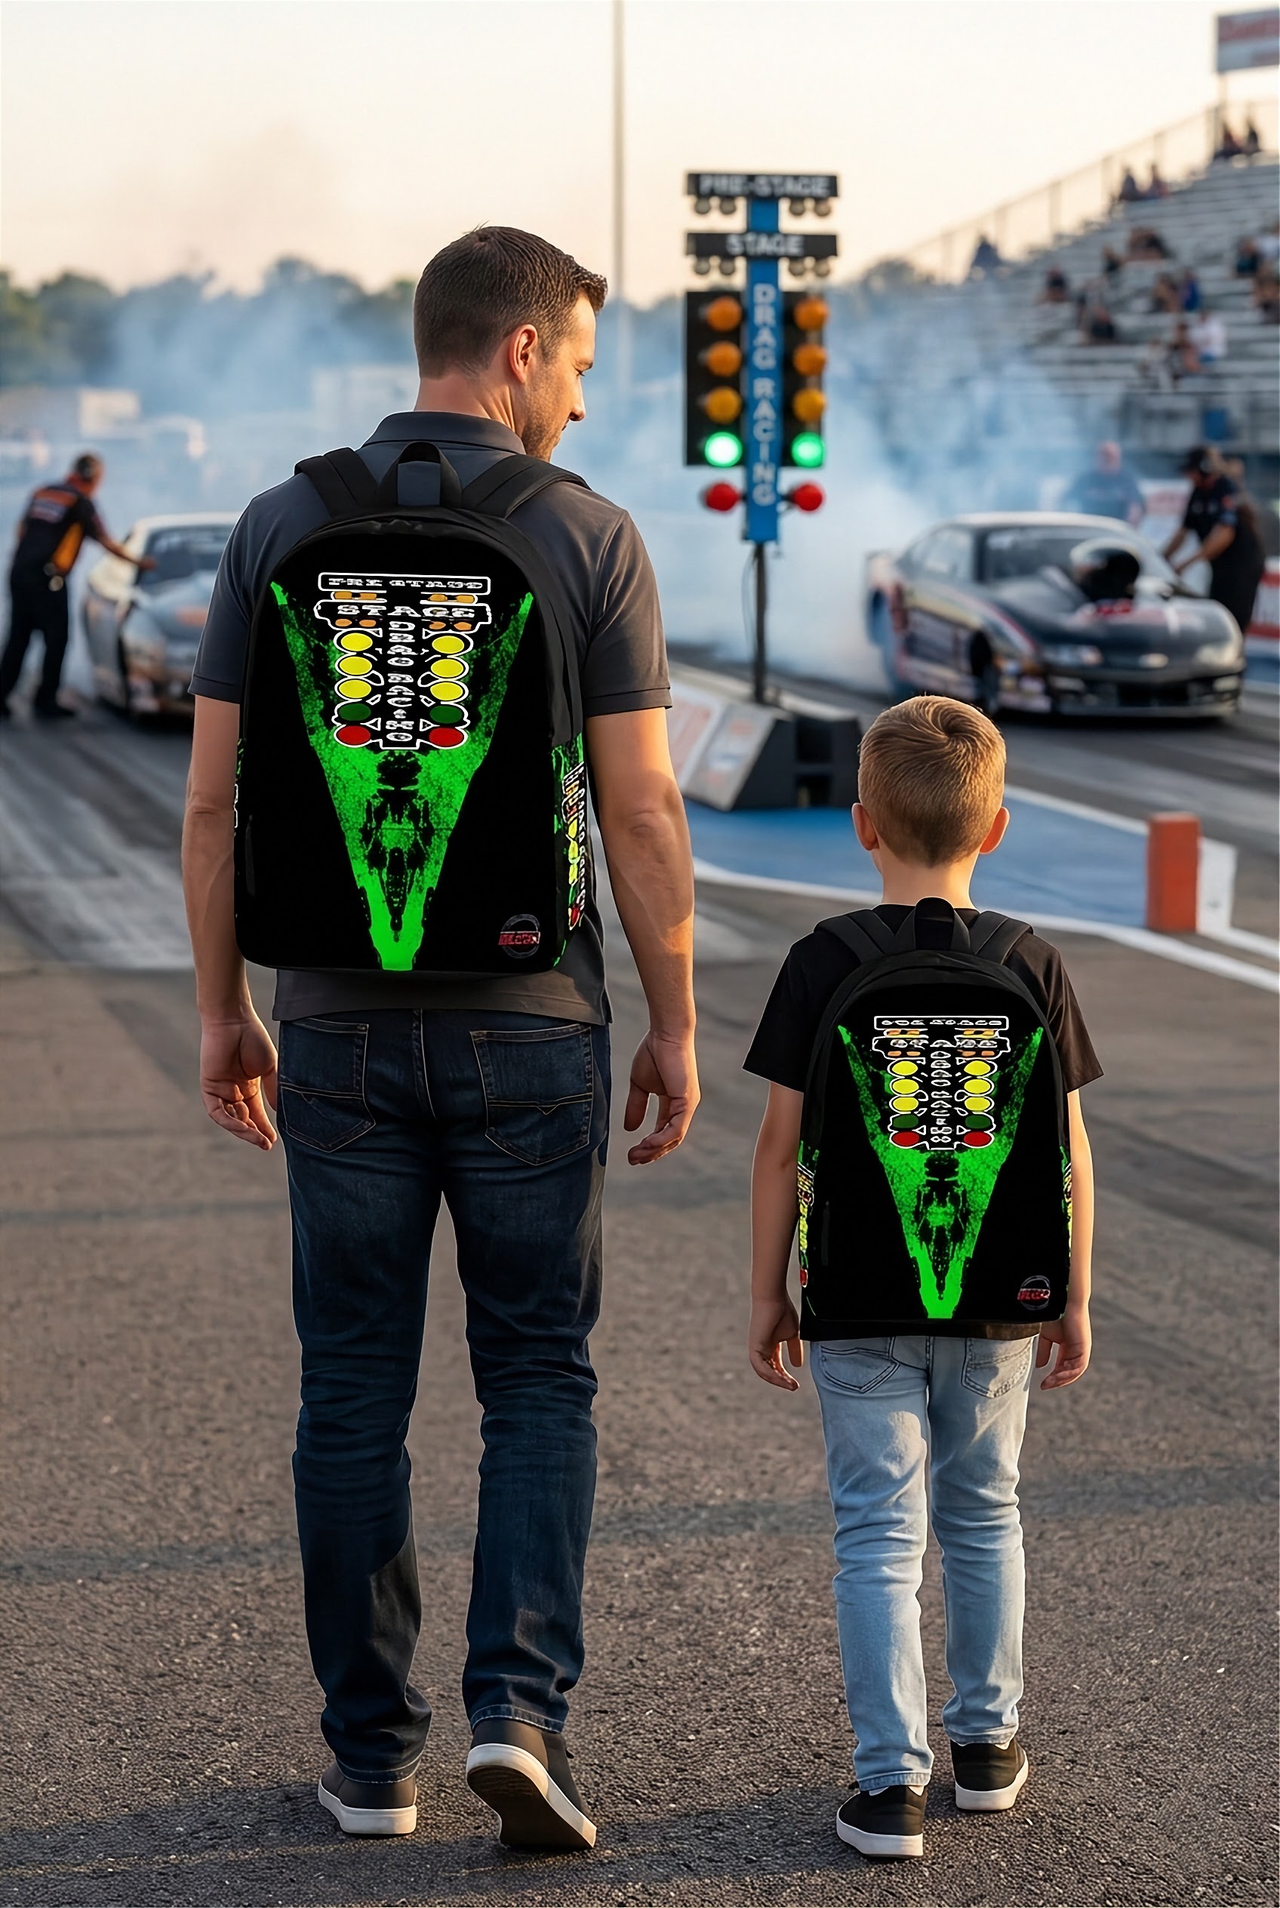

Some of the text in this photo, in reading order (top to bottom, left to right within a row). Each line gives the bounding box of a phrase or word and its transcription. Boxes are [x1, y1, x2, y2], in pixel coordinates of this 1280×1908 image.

[699, 174, 830, 197] PRE-STAGE
[726, 234, 804, 256] STAGE
[753, 284, 776, 506] DRAG RACING
